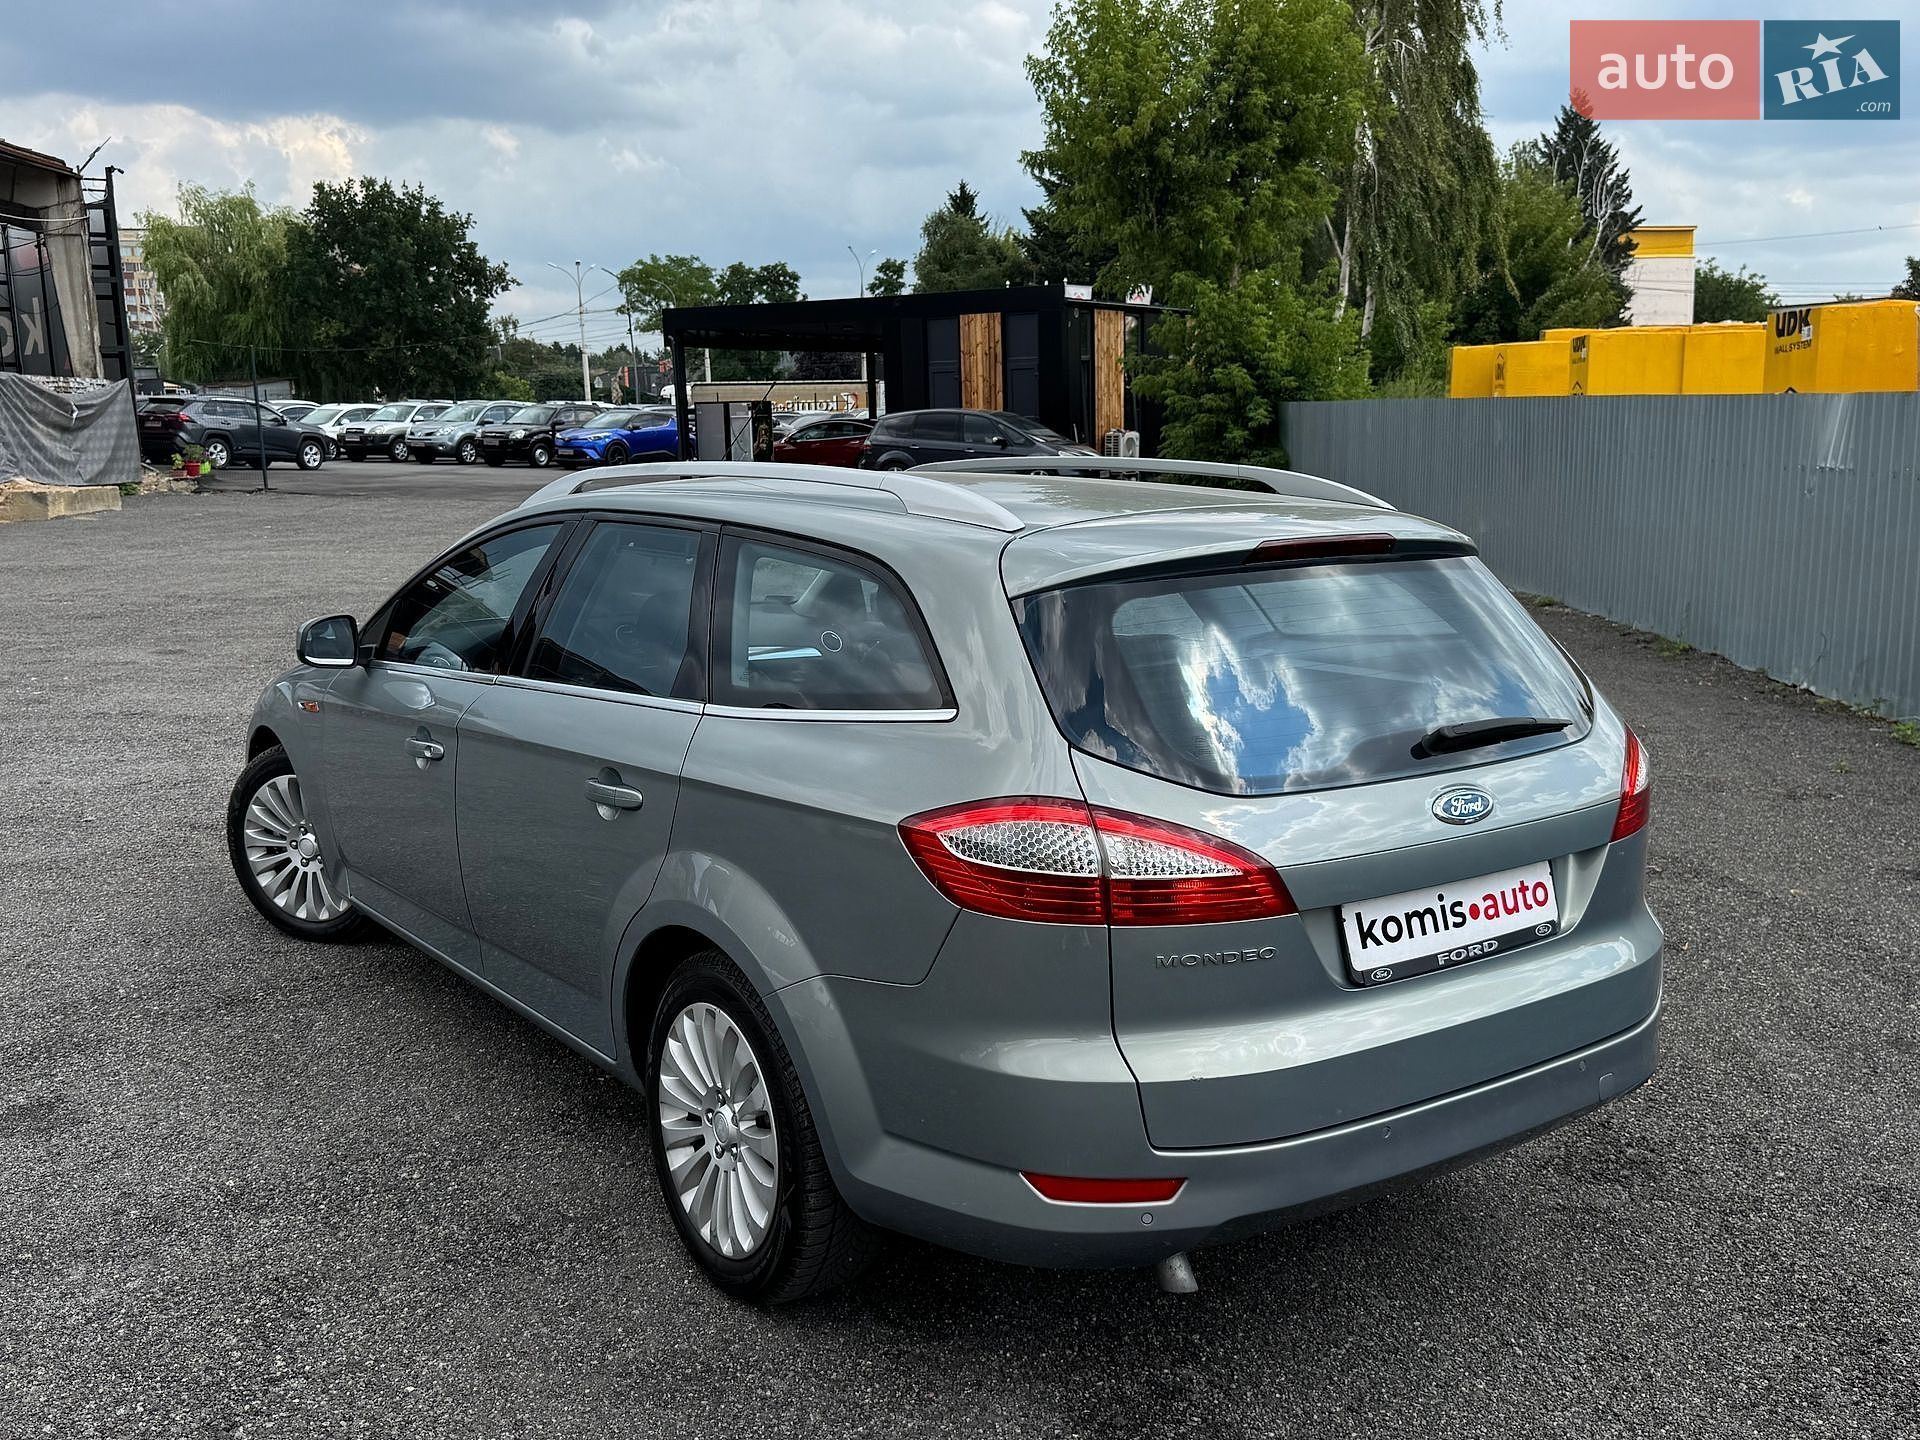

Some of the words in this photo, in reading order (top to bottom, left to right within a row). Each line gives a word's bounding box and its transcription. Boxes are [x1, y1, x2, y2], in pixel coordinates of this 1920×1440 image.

[1775, 308, 1811, 337] UDK
[1450, 795, 1483, 816] Ford
[1156, 946, 1277, 969] MONDEO
[1437, 940, 1499, 965] FORD
